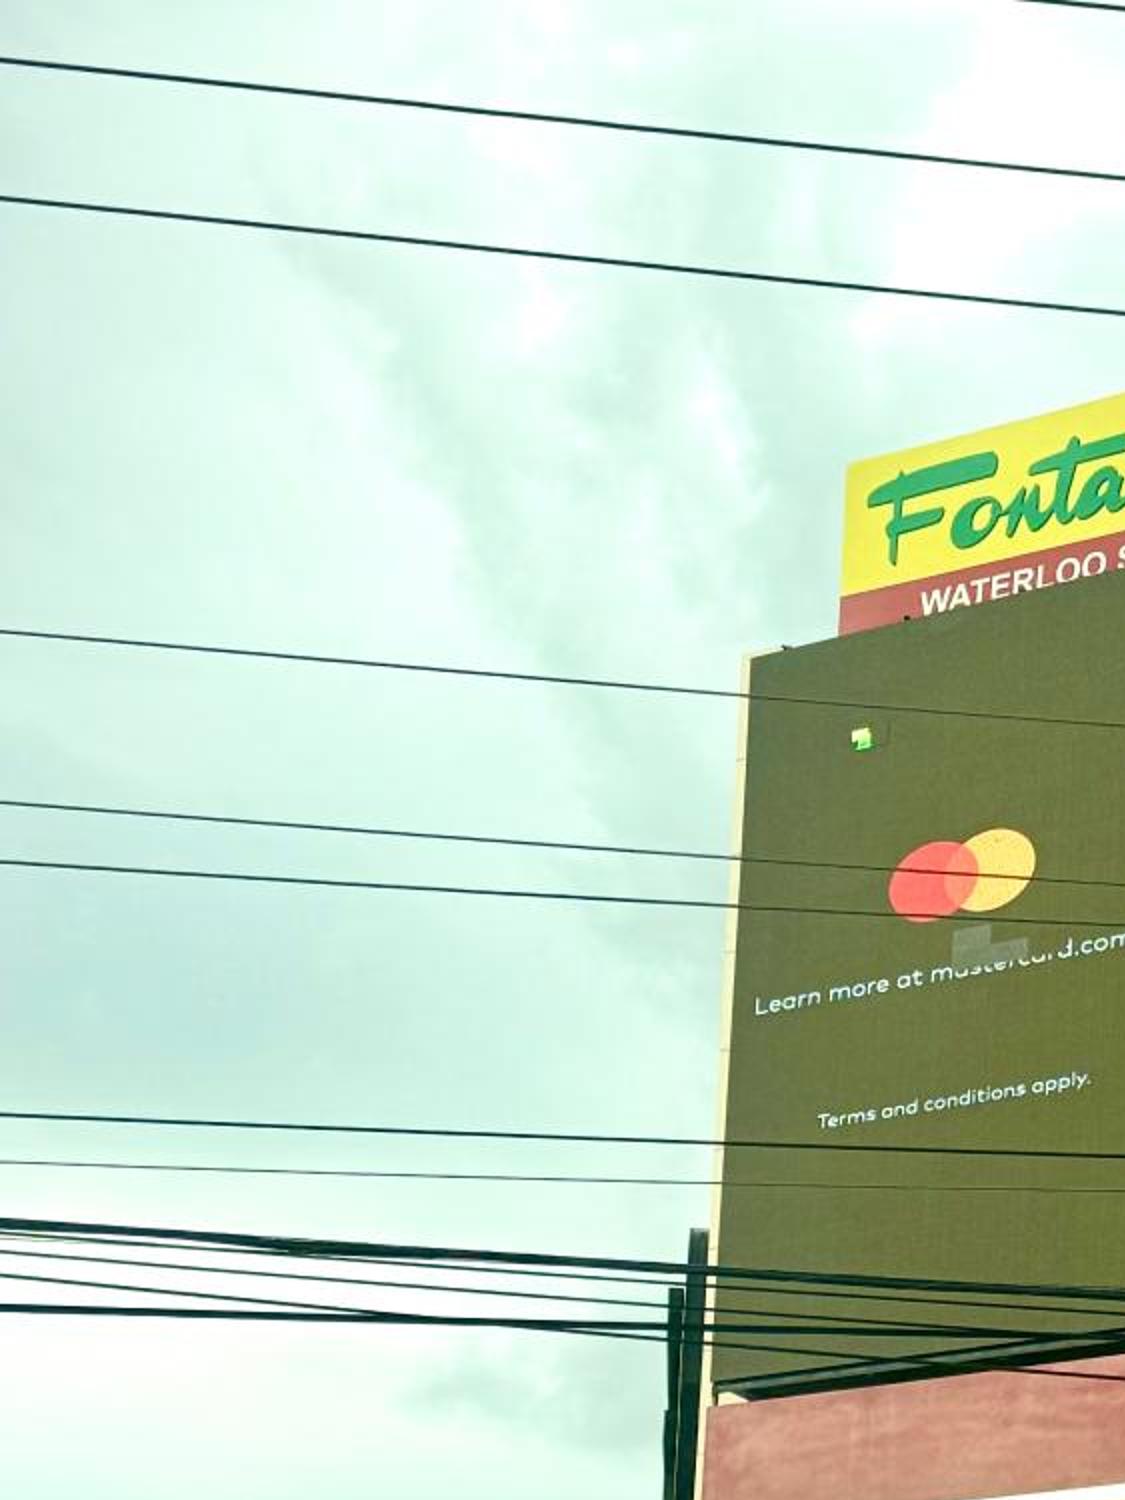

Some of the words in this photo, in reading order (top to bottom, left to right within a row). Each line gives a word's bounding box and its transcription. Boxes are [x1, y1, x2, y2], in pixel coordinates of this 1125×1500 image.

[919, 550, 1107, 617] WATERLOO
[755, 990, 821, 1015] Learn
[829, 978, 889, 1002] more
[897, 970, 923, 989] at
[817, 1107, 877, 1129] Terms
[881, 1099, 919, 1119] and
[923, 1082, 1027, 1112] conditions
[1031, 1071, 1092, 1097] apply.
